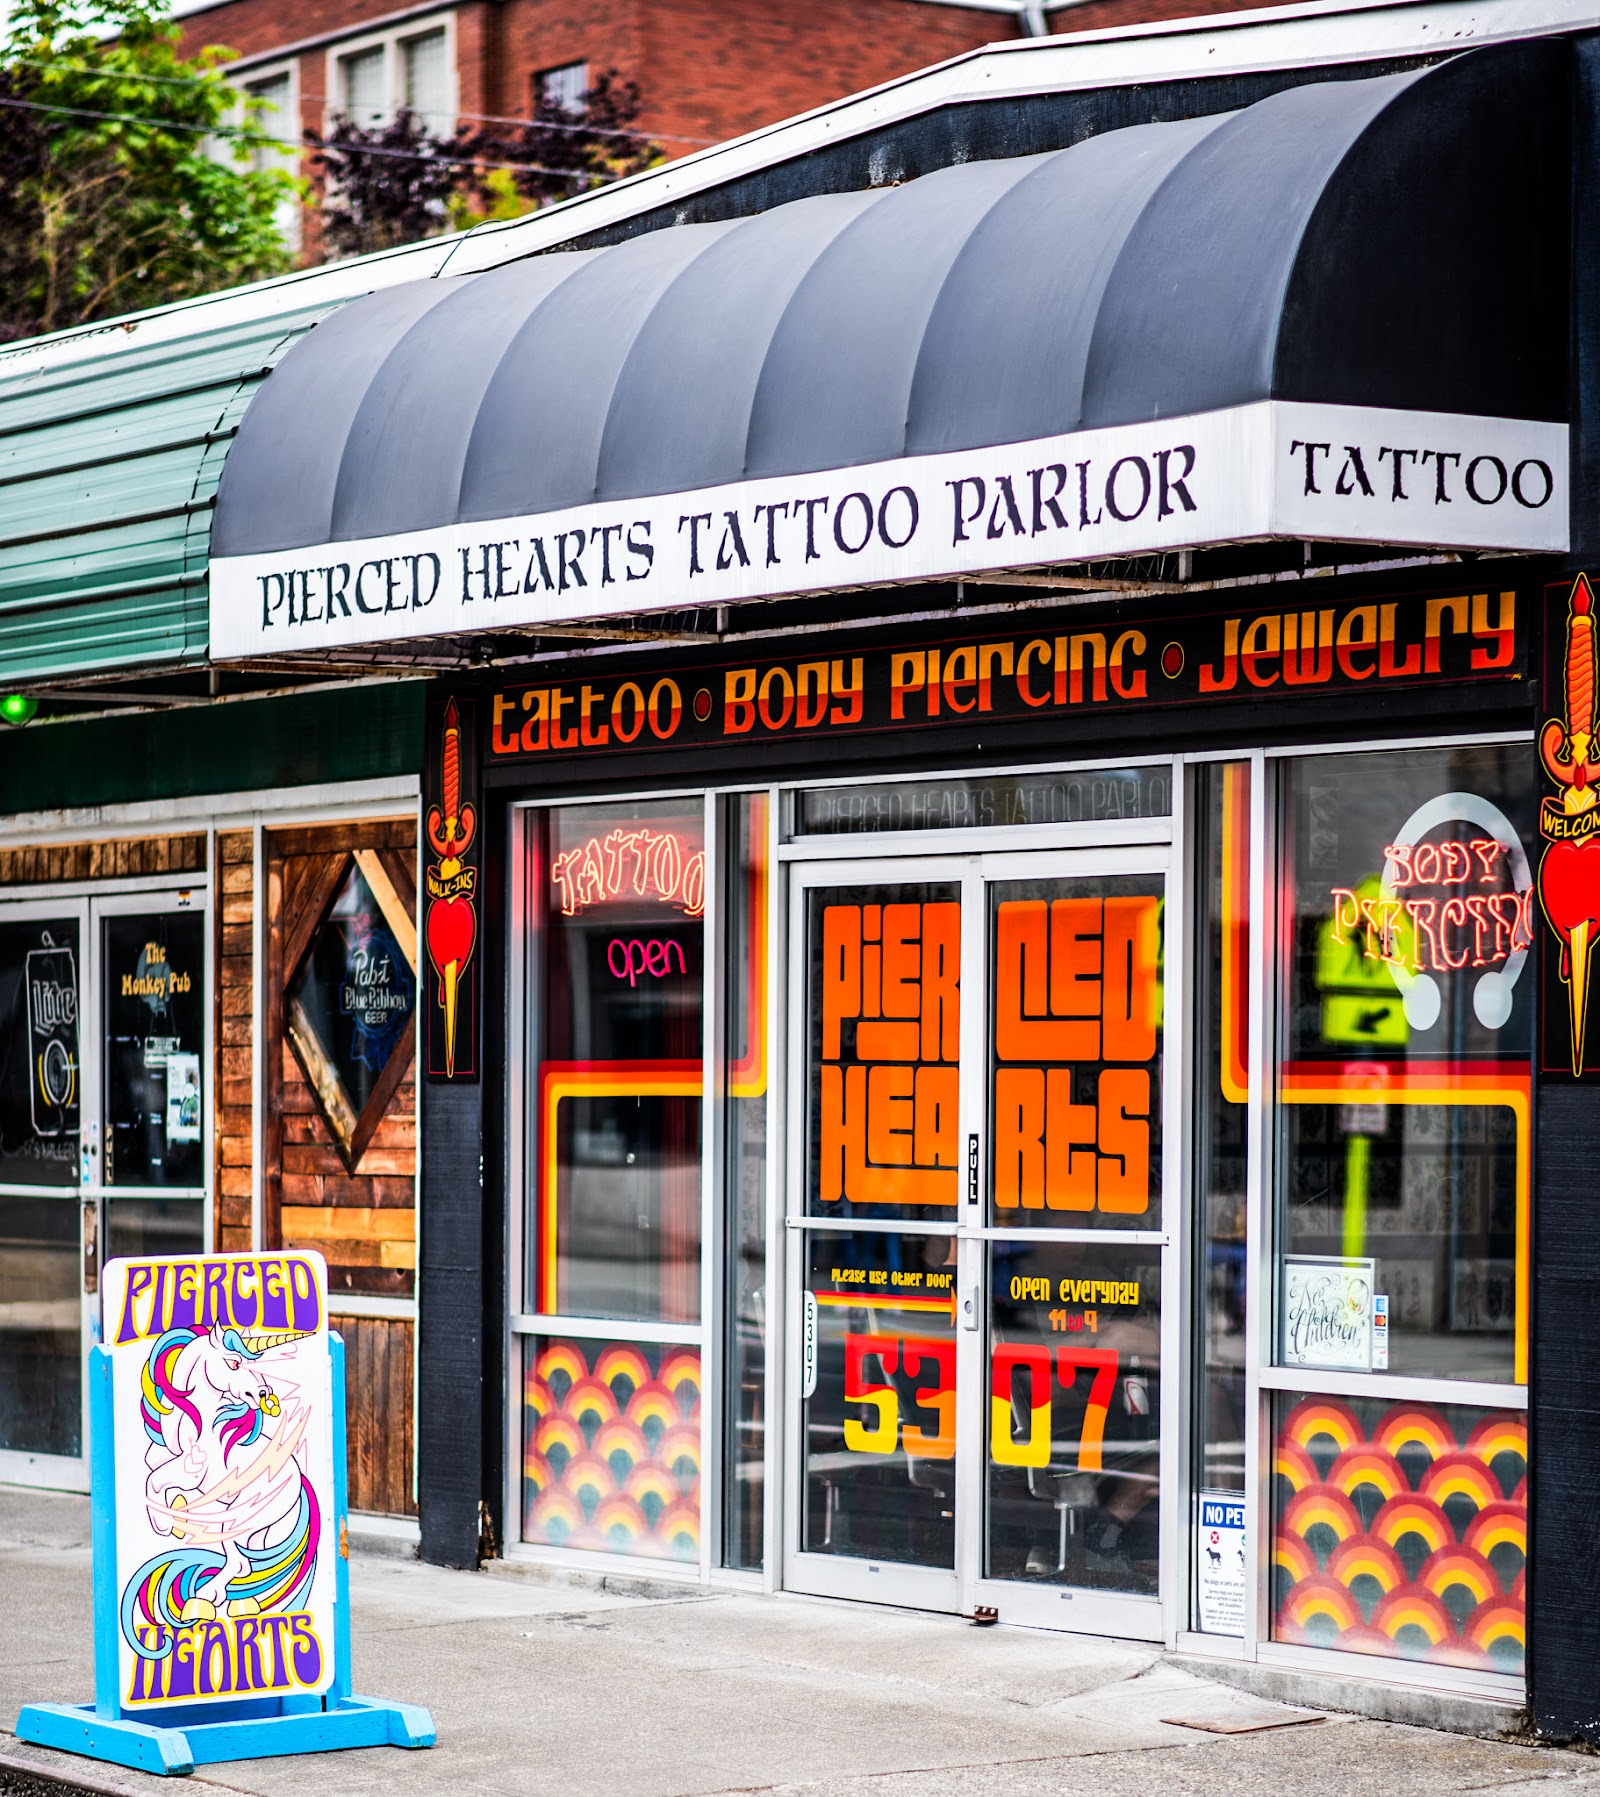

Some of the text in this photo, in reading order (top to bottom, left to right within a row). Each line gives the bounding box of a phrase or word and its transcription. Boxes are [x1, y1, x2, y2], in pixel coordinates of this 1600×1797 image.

[1288, 439, 1554, 509] TATTOO
[257, 444, 1199, 632] PIERCED HEARTS TATTOO PARLOR
[1091, 776, 1170, 821] PARLO
[428, 871, 474, 898] WALK-INS
[1383, 838, 1500, 889] BODY
[145, 942, 166, 965] The
[32, 979, 77, 1037] Lite
[121, 971, 191, 998] Monkey Pub
[345, 986, 407, 1012] Blue Ribbon
[364, 1011, 388, 1024] BEER
[969, 1139, 978, 1200] PULL
[114, 1258, 324, 1348] PIERCED
[1205, 1505, 1224, 1525] NO
[127, 1609, 325, 1704] HEARTS
